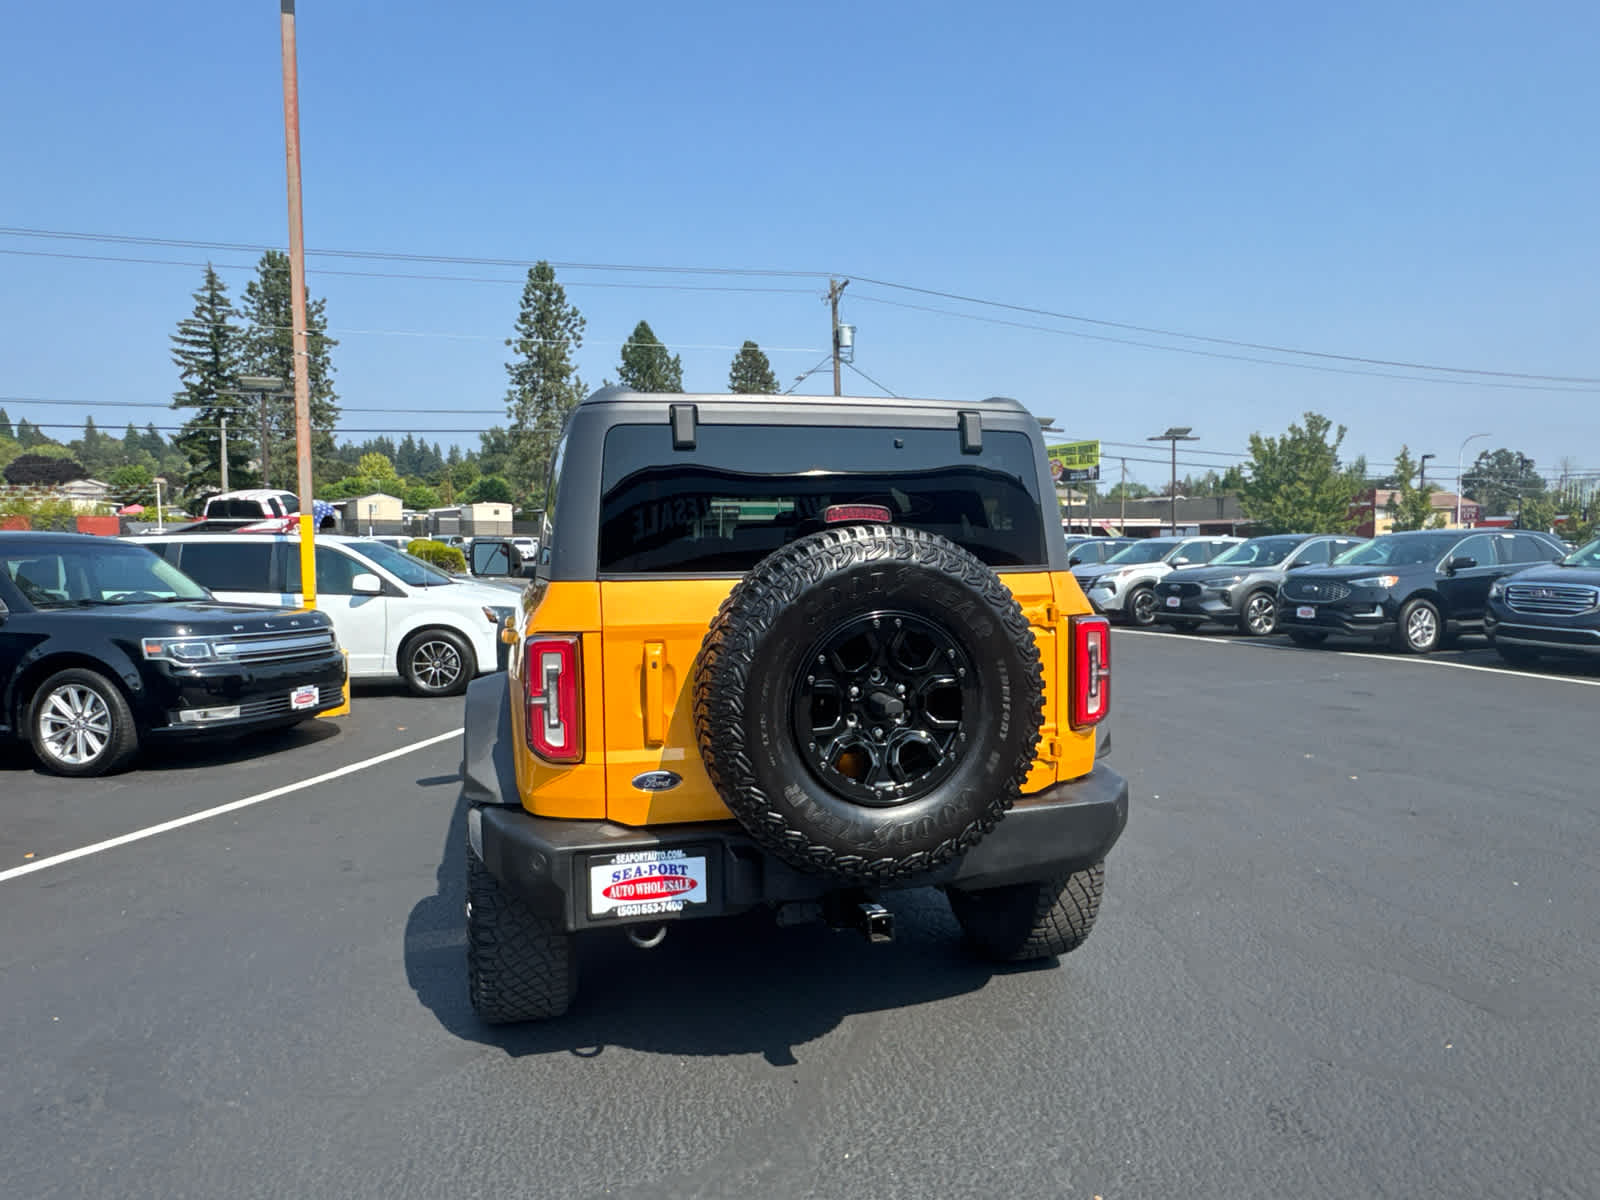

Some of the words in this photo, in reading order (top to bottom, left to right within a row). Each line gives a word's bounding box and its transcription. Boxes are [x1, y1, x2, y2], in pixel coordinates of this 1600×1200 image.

[616, 850, 683, 863] SEAPORTAUTO.COM
[609, 884, 635, 898] AUTO
[635, 878, 692, 895] WHOLESALE
